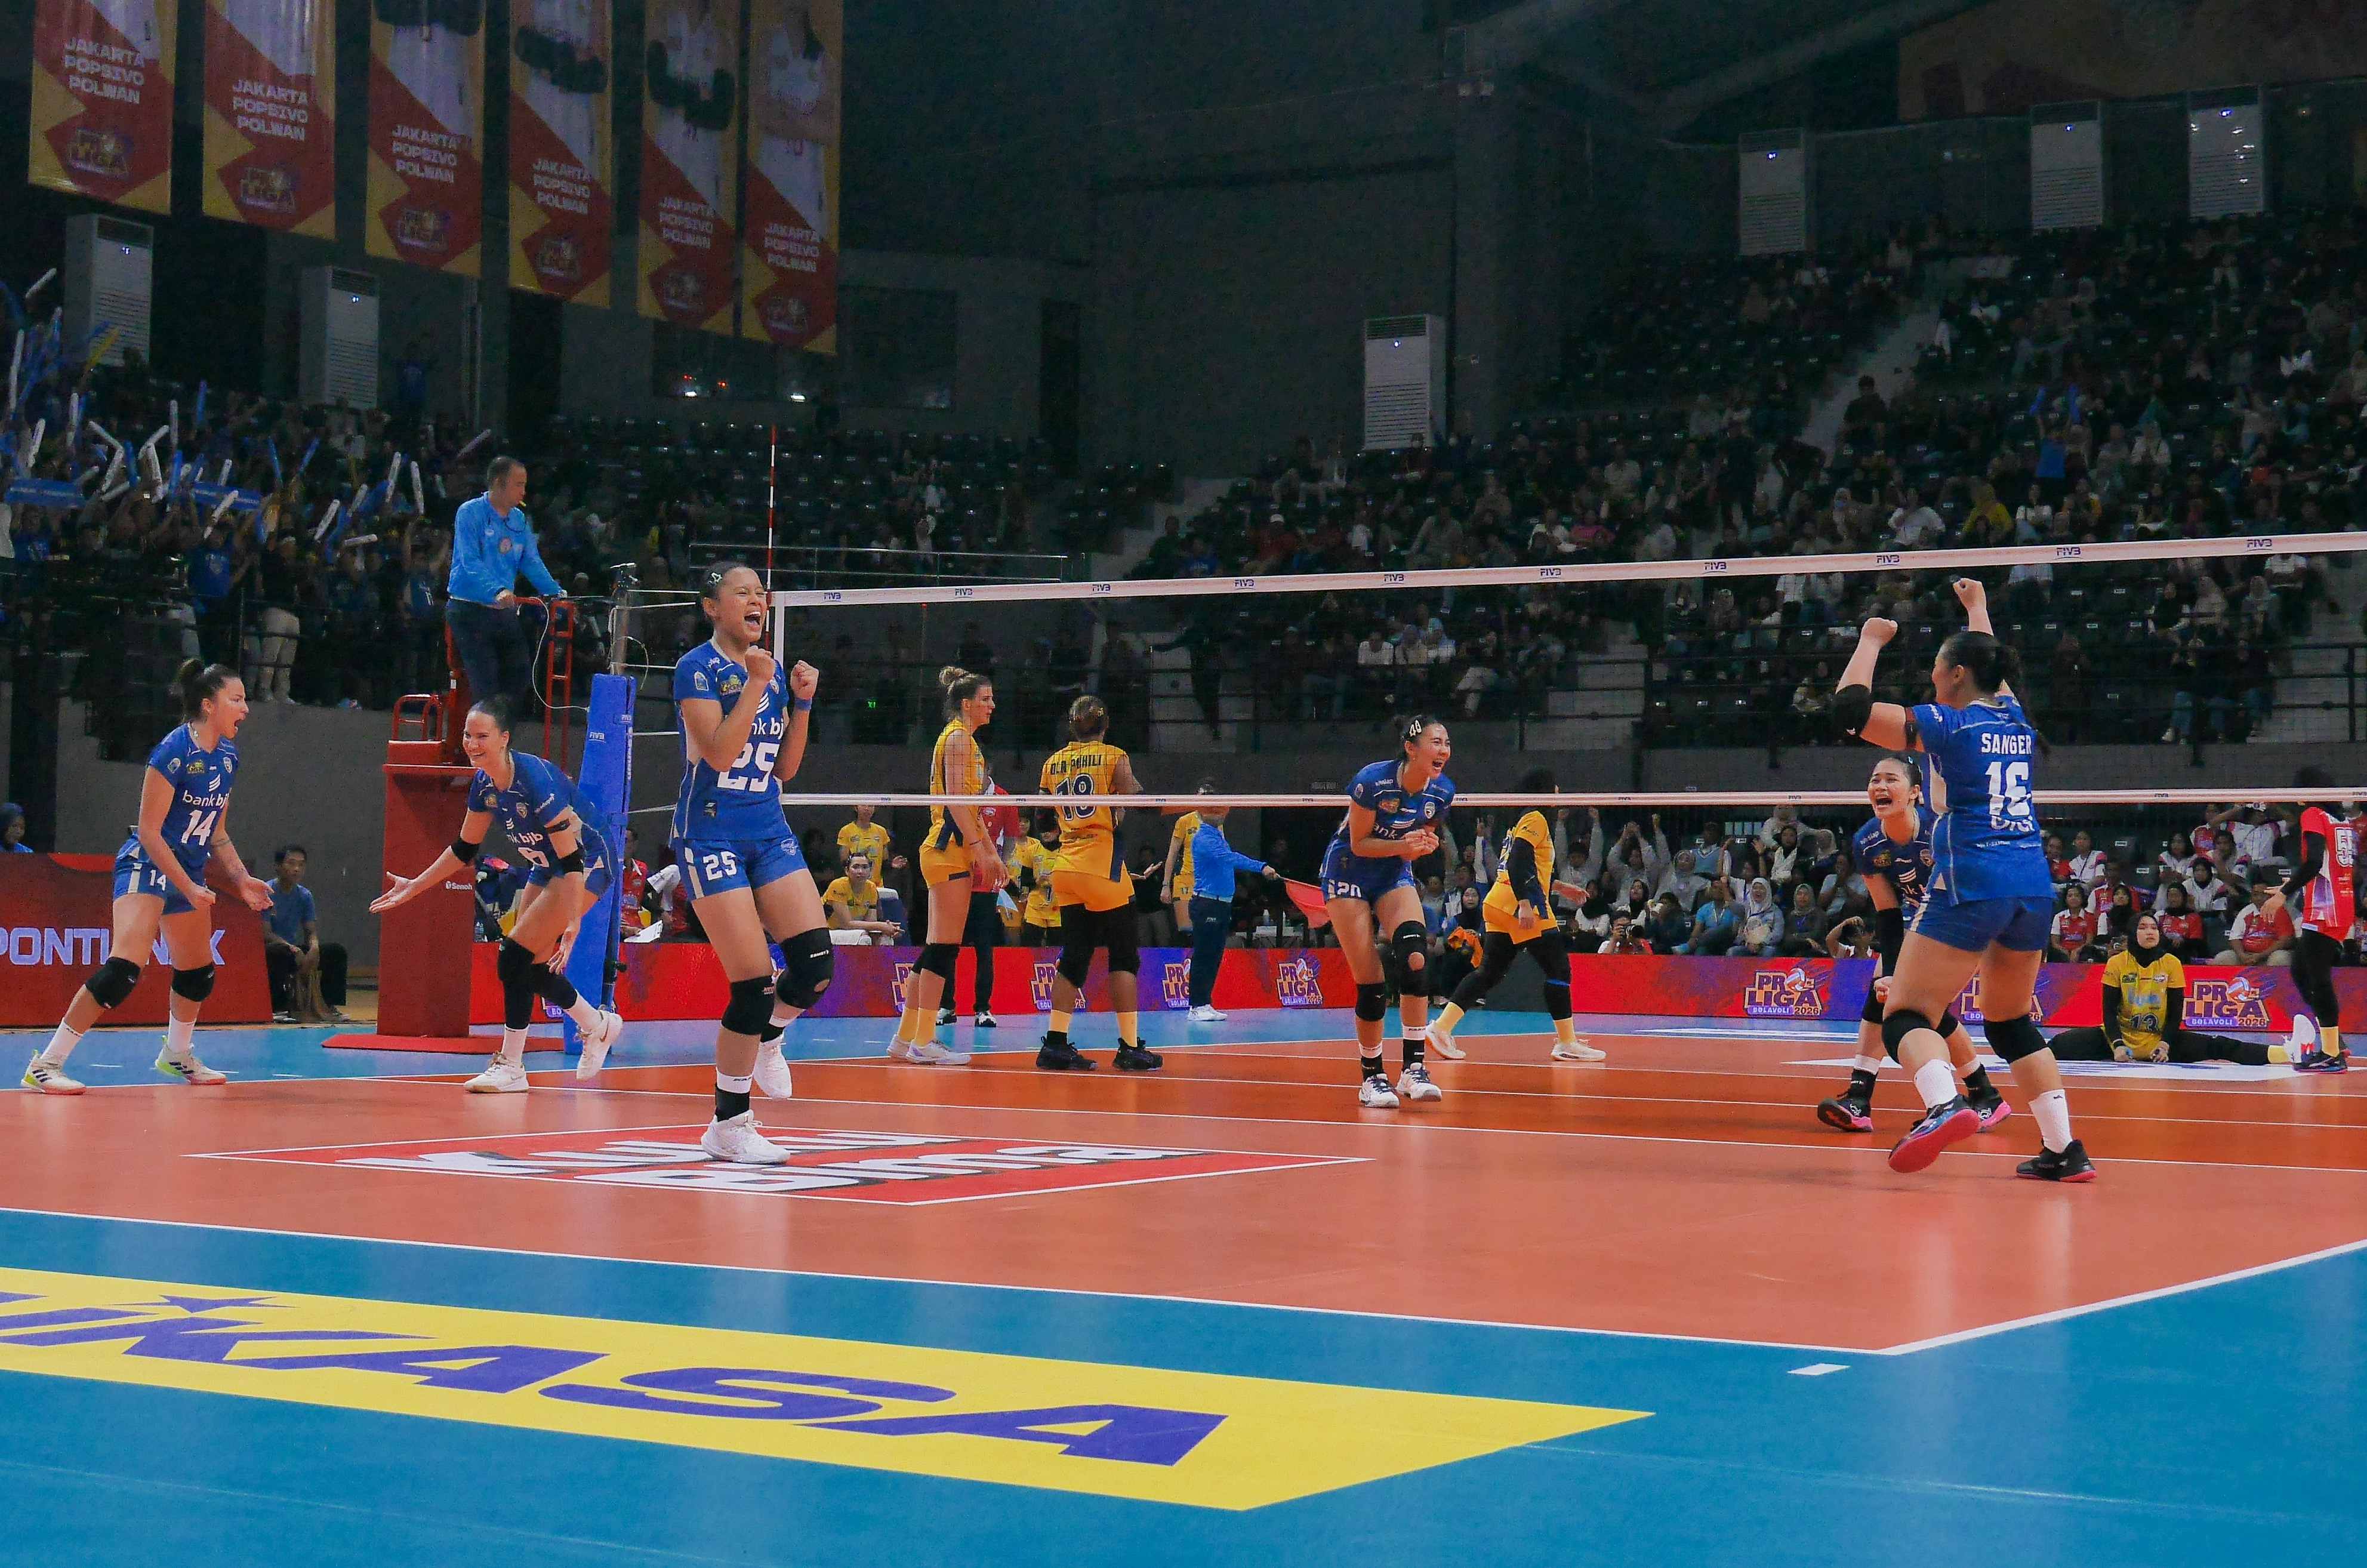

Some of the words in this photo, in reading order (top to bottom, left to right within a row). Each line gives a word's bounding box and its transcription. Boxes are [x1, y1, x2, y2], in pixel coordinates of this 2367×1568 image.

[64, 37, 145, 68] JAKARTA
[65, 54, 144, 85] POPSIVO
[69, 75, 140, 104] POLWAN
[232, 79, 308, 104] JAKARTA
[233, 96, 308, 123] POPSIVO
[238, 115, 305, 141] POLWAN
[392, 124, 457, 150] JAKARTA
[396, 159, 454, 183] POLWAN
[532, 158, 591, 181] JAKARTA
[538, 191, 588, 214] POLWAN
[659, 197, 715, 217] JAKARTA
[662, 227, 710, 249] POLWAN
[765, 223, 821, 243] JAKARTA
[768, 252, 817, 272] POLWAN
[2056, 547, 2081, 556] FIVB
[2246, 538, 2272, 547] FIVB
[1705, 562, 1727, 570] FIVB
[1876, 555, 1900, 563] FIVB
[751, 717, 766, 735] nk
[769, 717, 784, 740] bj
[1981, 733, 2032, 754] SANGER
[717, 742, 780, 793] 25
[182, 789, 214, 807] bank
[215, 793, 230, 809] bj
[1985, 761, 2032, 816] 16
[181, 809, 217, 846] 14
[518, 831, 544, 845] bjb
[1373, 822, 1398, 840] ank
[702, 851, 737, 881] 25
[150, 869, 167, 891] 14
[1337, 882, 1361, 898] 20
[1279, 979, 1320, 997] LIGA
[1748, 990, 1819, 1006] LIGA
[2185, 1000, 2263, 1018] LIGA
[575, 1145, 1210, 1193] Bima
[0, 1292, 1228, 1467] IKASA
